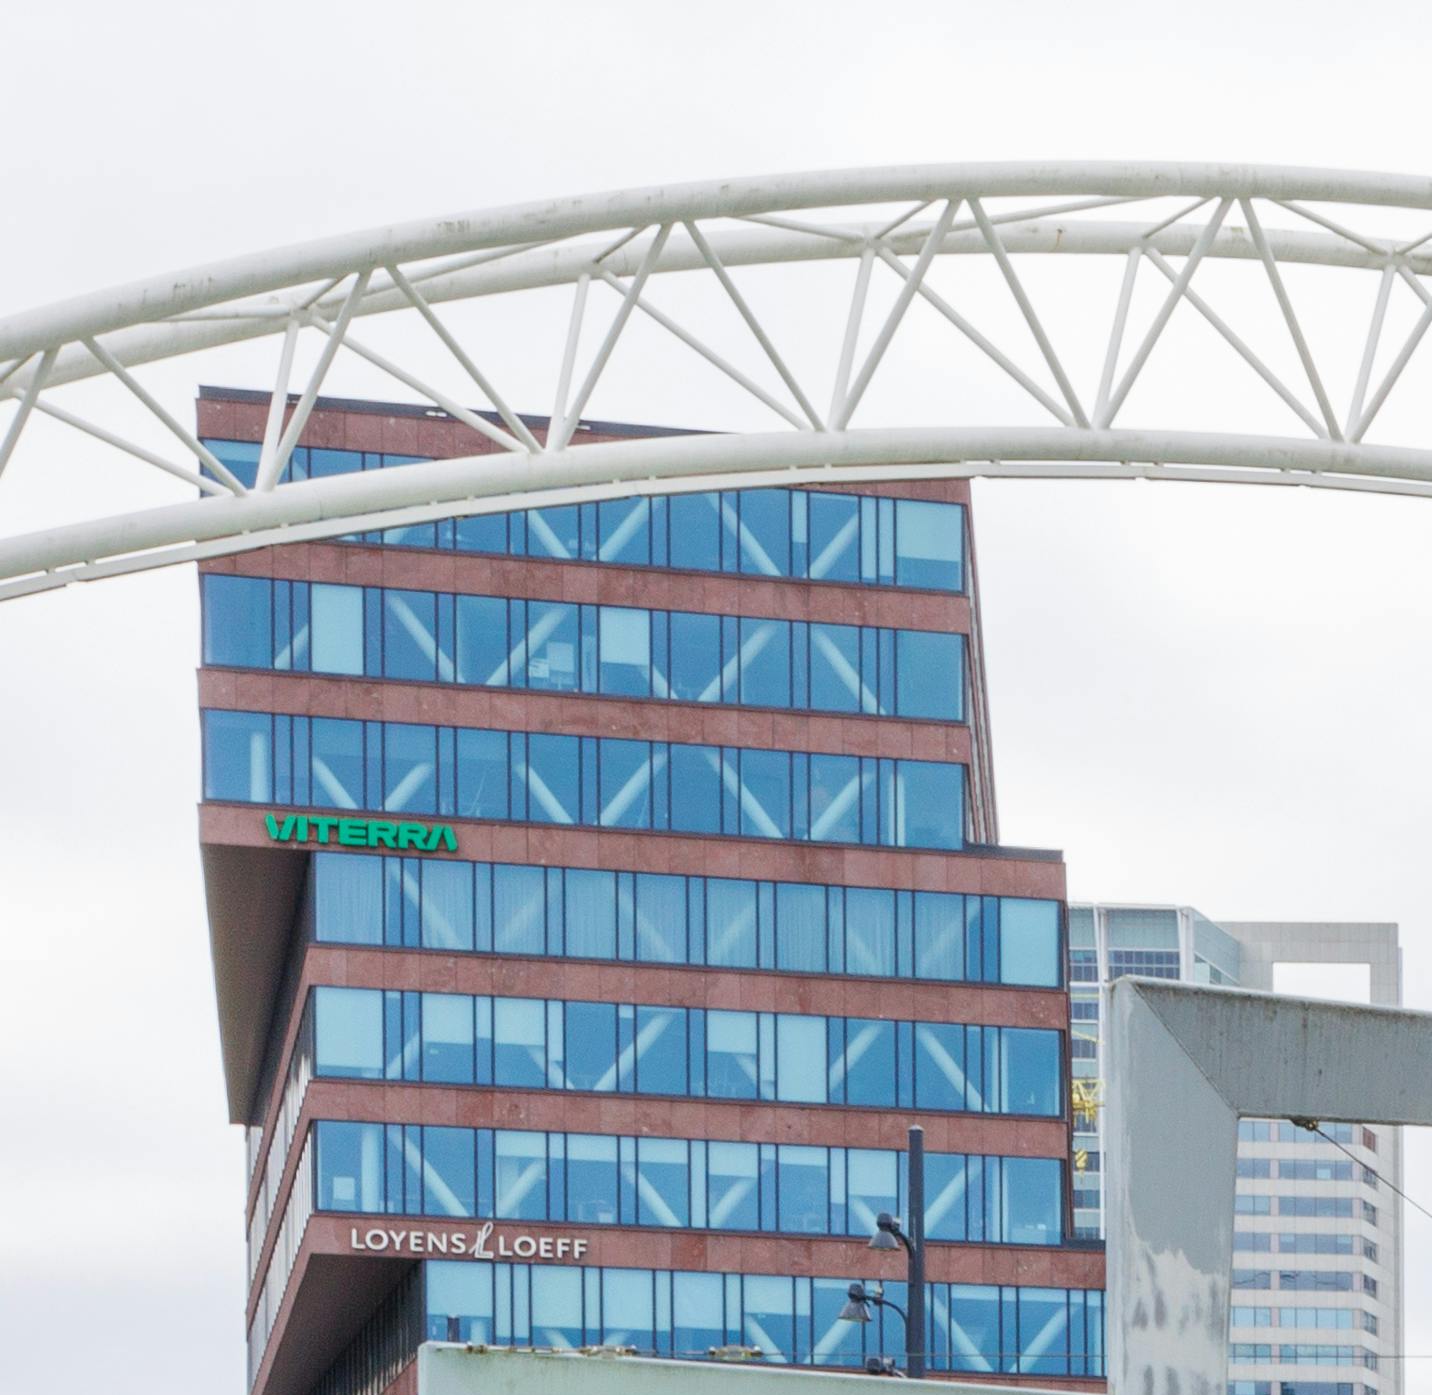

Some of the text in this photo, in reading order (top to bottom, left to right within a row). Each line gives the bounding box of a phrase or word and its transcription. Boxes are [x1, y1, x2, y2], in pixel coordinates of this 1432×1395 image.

[264, 814, 458, 852] VITERRA
[350, 1226, 465, 1254] LOYENS
[497, 1235, 589, 1260] LOEFF
